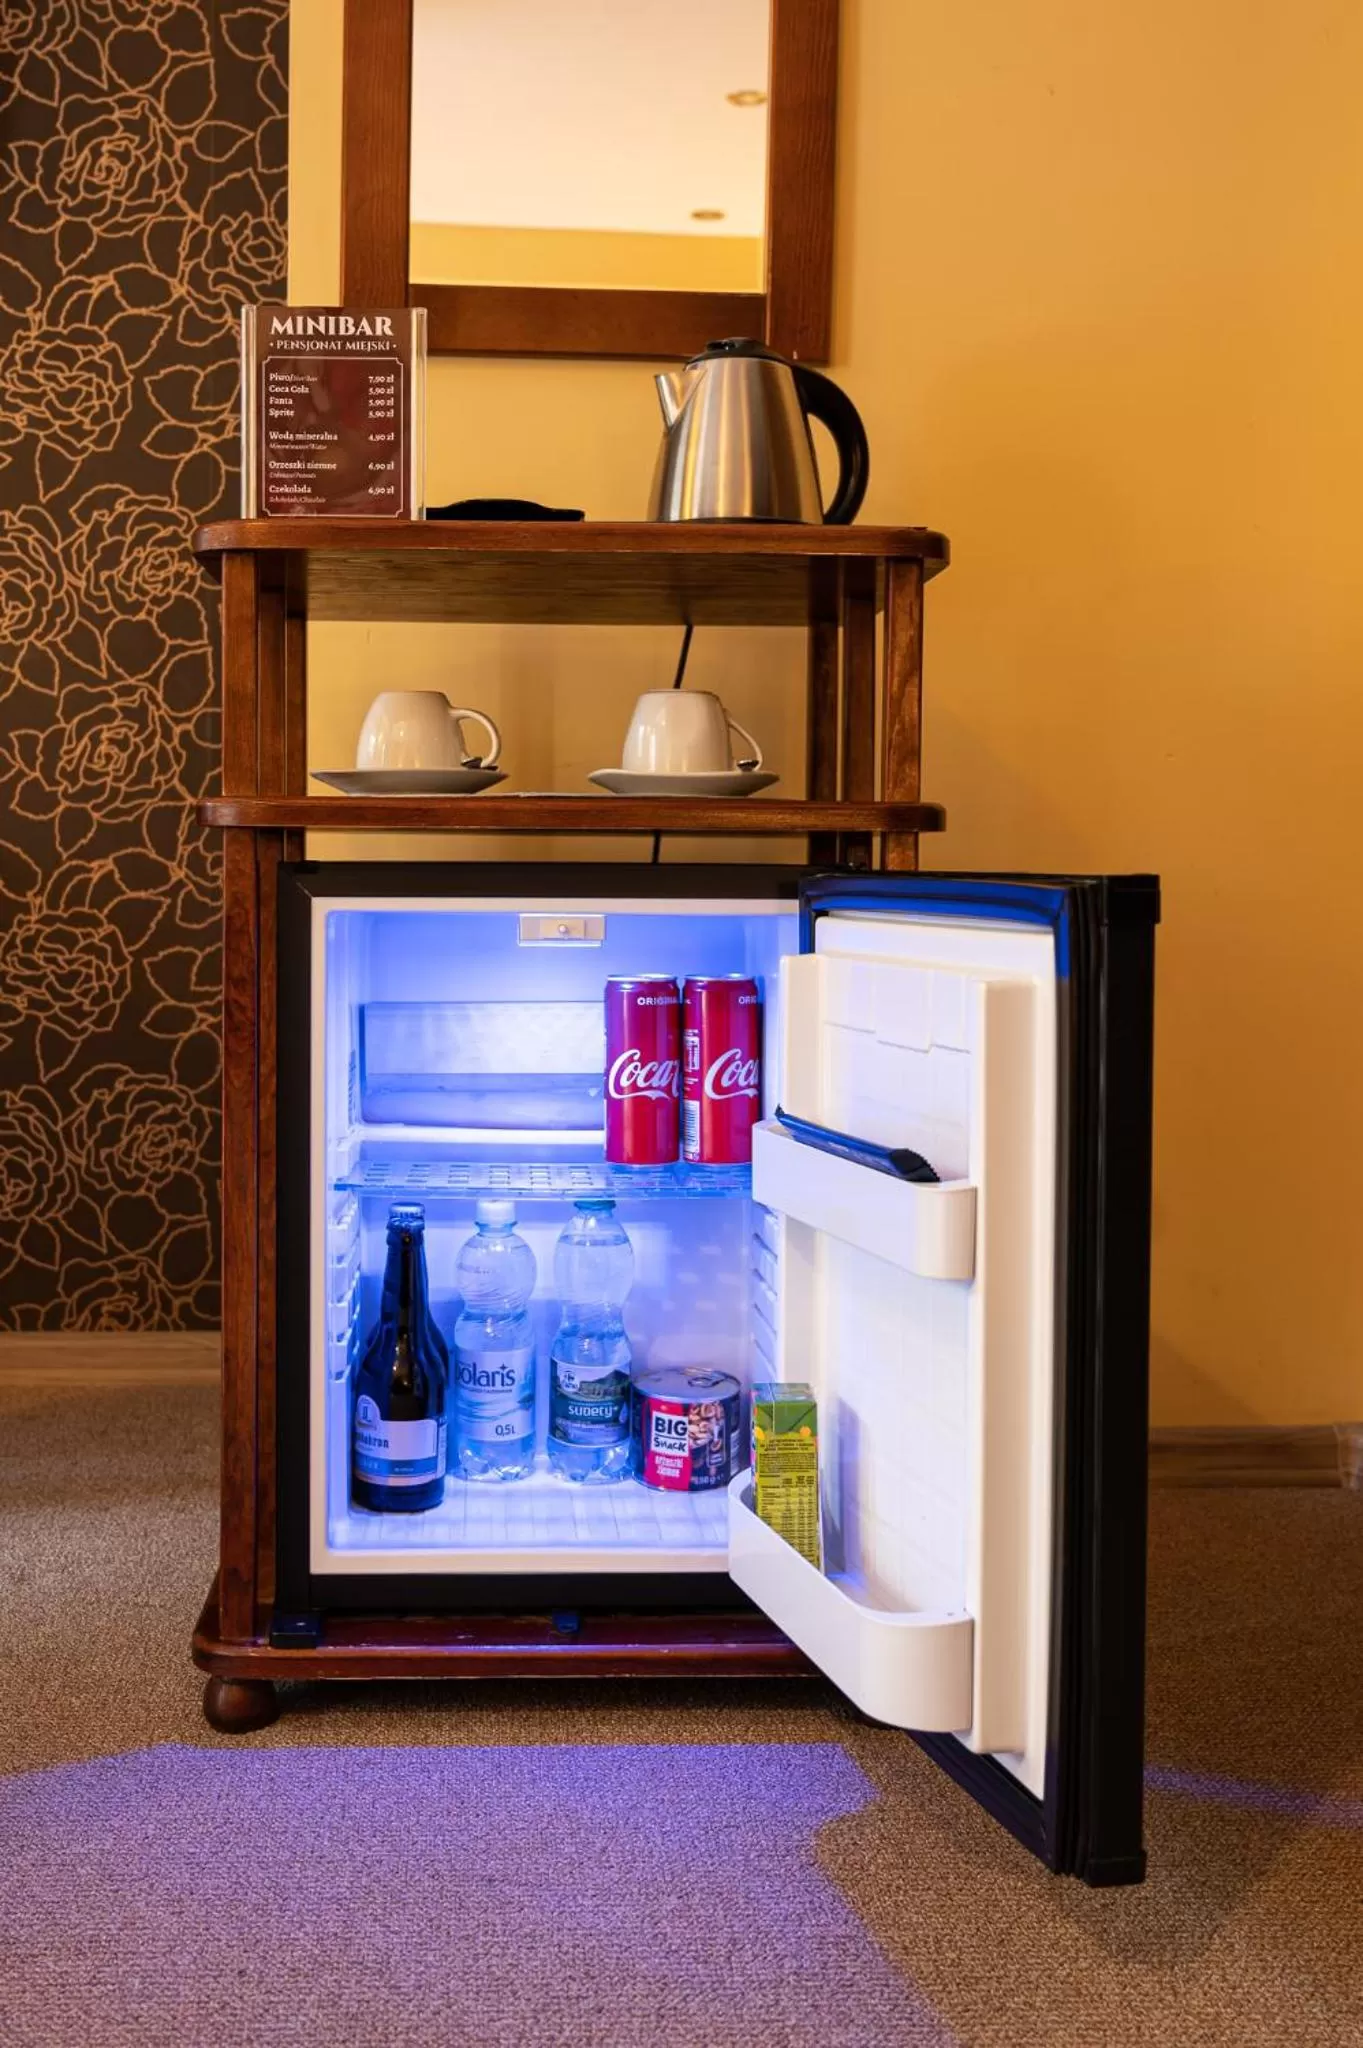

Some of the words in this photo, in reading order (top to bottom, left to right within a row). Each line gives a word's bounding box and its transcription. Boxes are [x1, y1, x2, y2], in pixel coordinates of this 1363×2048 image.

[270, 316, 394, 336] MINIBAR
[276, 339, 342, 351] PENSJONAT
[345, 340, 390, 352] MIEJSKI
[269, 384, 289, 393] Coca
[290, 384, 309, 393] Cola
[269, 396, 293, 405] Fanta
[268, 408, 295, 418] Sprite
[269, 431, 294, 441] Woda
[295, 431, 338, 440] mineralna
[268, 461, 305, 469] Orzeszki
[307, 462, 337, 470] ziemne
[268, 485, 312, 494] Czekolada
[655, 1415, 688, 1437] BIG
